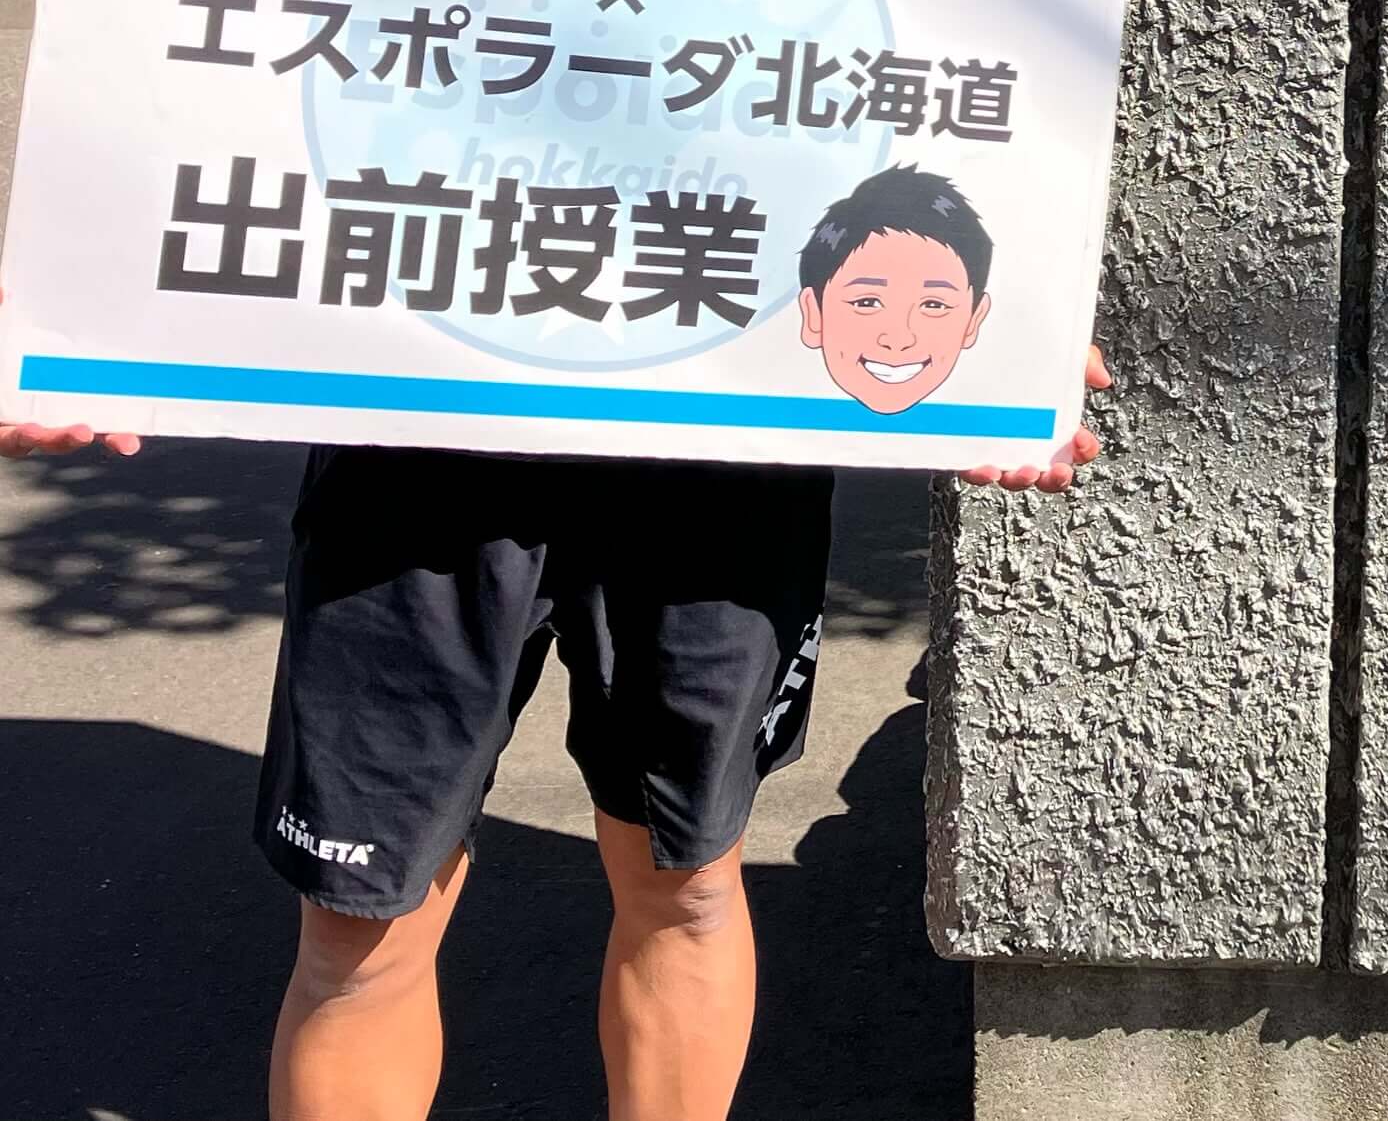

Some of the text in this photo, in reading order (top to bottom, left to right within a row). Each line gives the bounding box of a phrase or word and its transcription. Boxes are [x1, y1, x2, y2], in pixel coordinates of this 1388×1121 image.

[155, 155, 770, 330] 出前授業
[276, 816, 370, 866] ATHLETA
